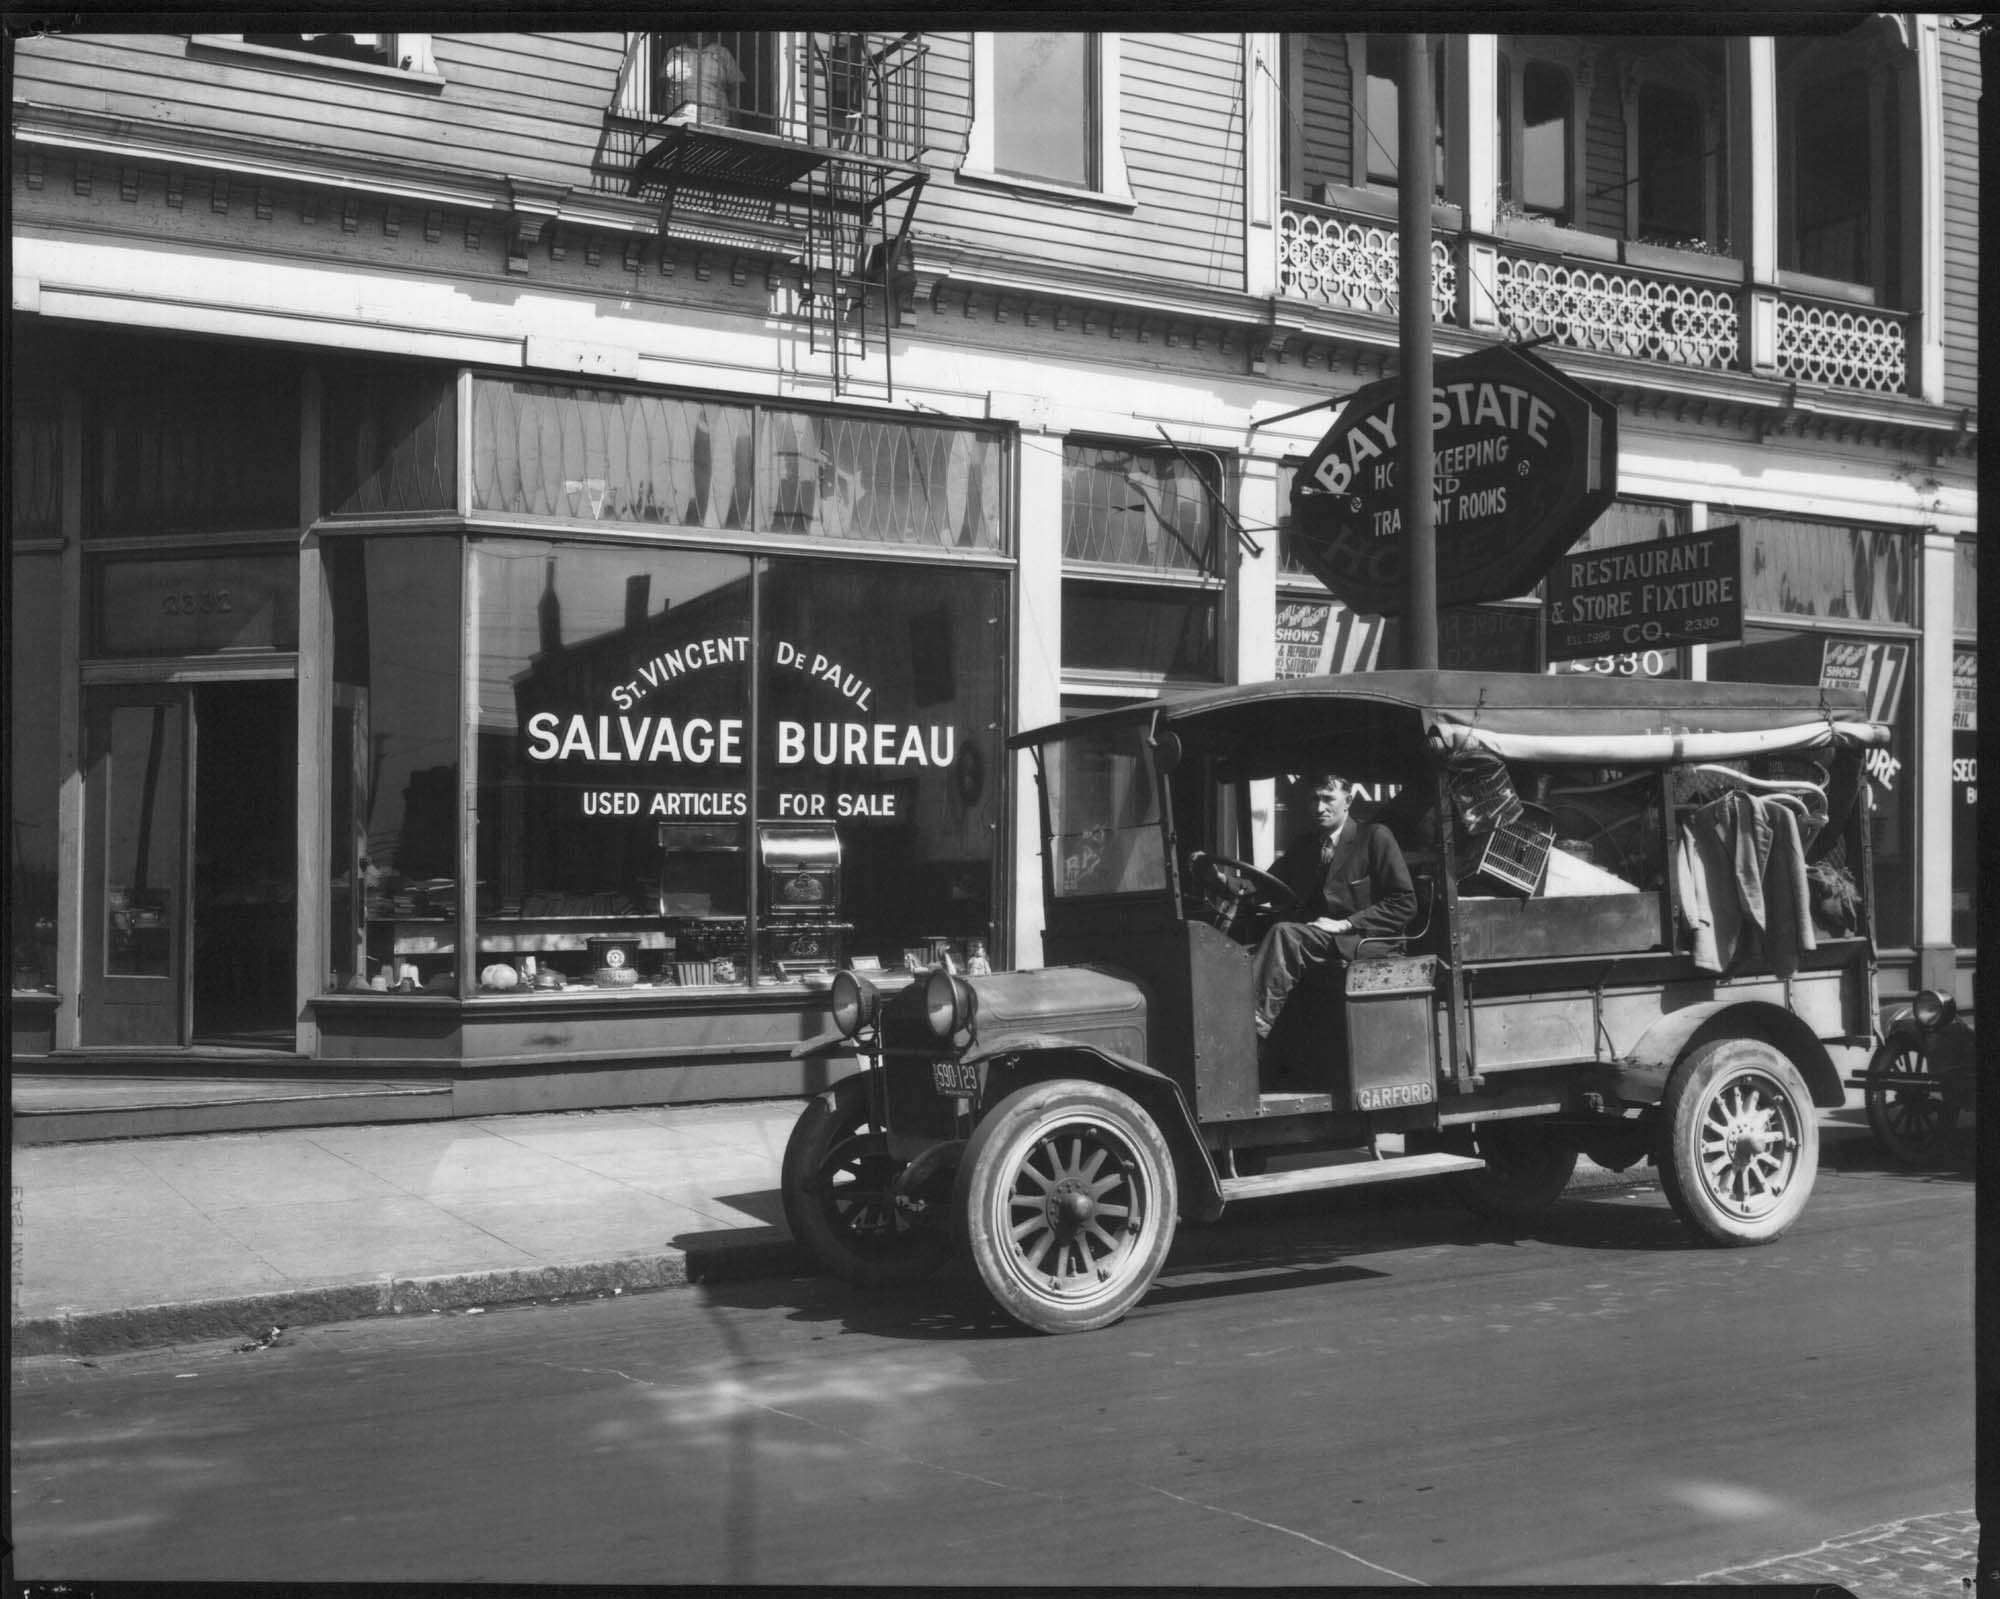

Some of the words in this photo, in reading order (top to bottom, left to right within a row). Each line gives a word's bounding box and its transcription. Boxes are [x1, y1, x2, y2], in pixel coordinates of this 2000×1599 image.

[1314, 402, 1398, 494] BAY
[1433, 477, 1460, 496] ND
[1459, 486, 1507, 521] ROOMS
[1570, 541, 1713, 588] RESTAURANT
[1551, 601, 1567, 625] &
[1572, 591, 1633, 623] STORE
[1642, 576, 1734, 614] FIXTURE
[1275, 628, 1320, 643] SHOWS
[1329, 606, 1382, 674] 17
[1622, 620, 1671, 644] CO.
[1684, 616, 1720, 632] 2330
[638, 636, 750, 688] VINCENT
[810, 654, 872, 712] PAUL
[1825, 665, 1859, 679] SHOWS
[1867, 644, 1909, 722] 17
[527, 712, 743, 765] SALVAGE
[777, 721, 955, 768] BUREAU
[583, 792, 640, 816] USED
[649, 792, 747, 816] ARTICLES
[779, 793, 825, 816] FOR
[837, 793, 895, 816] SALE
[1360, 1083, 1433, 1108] GARFORD
